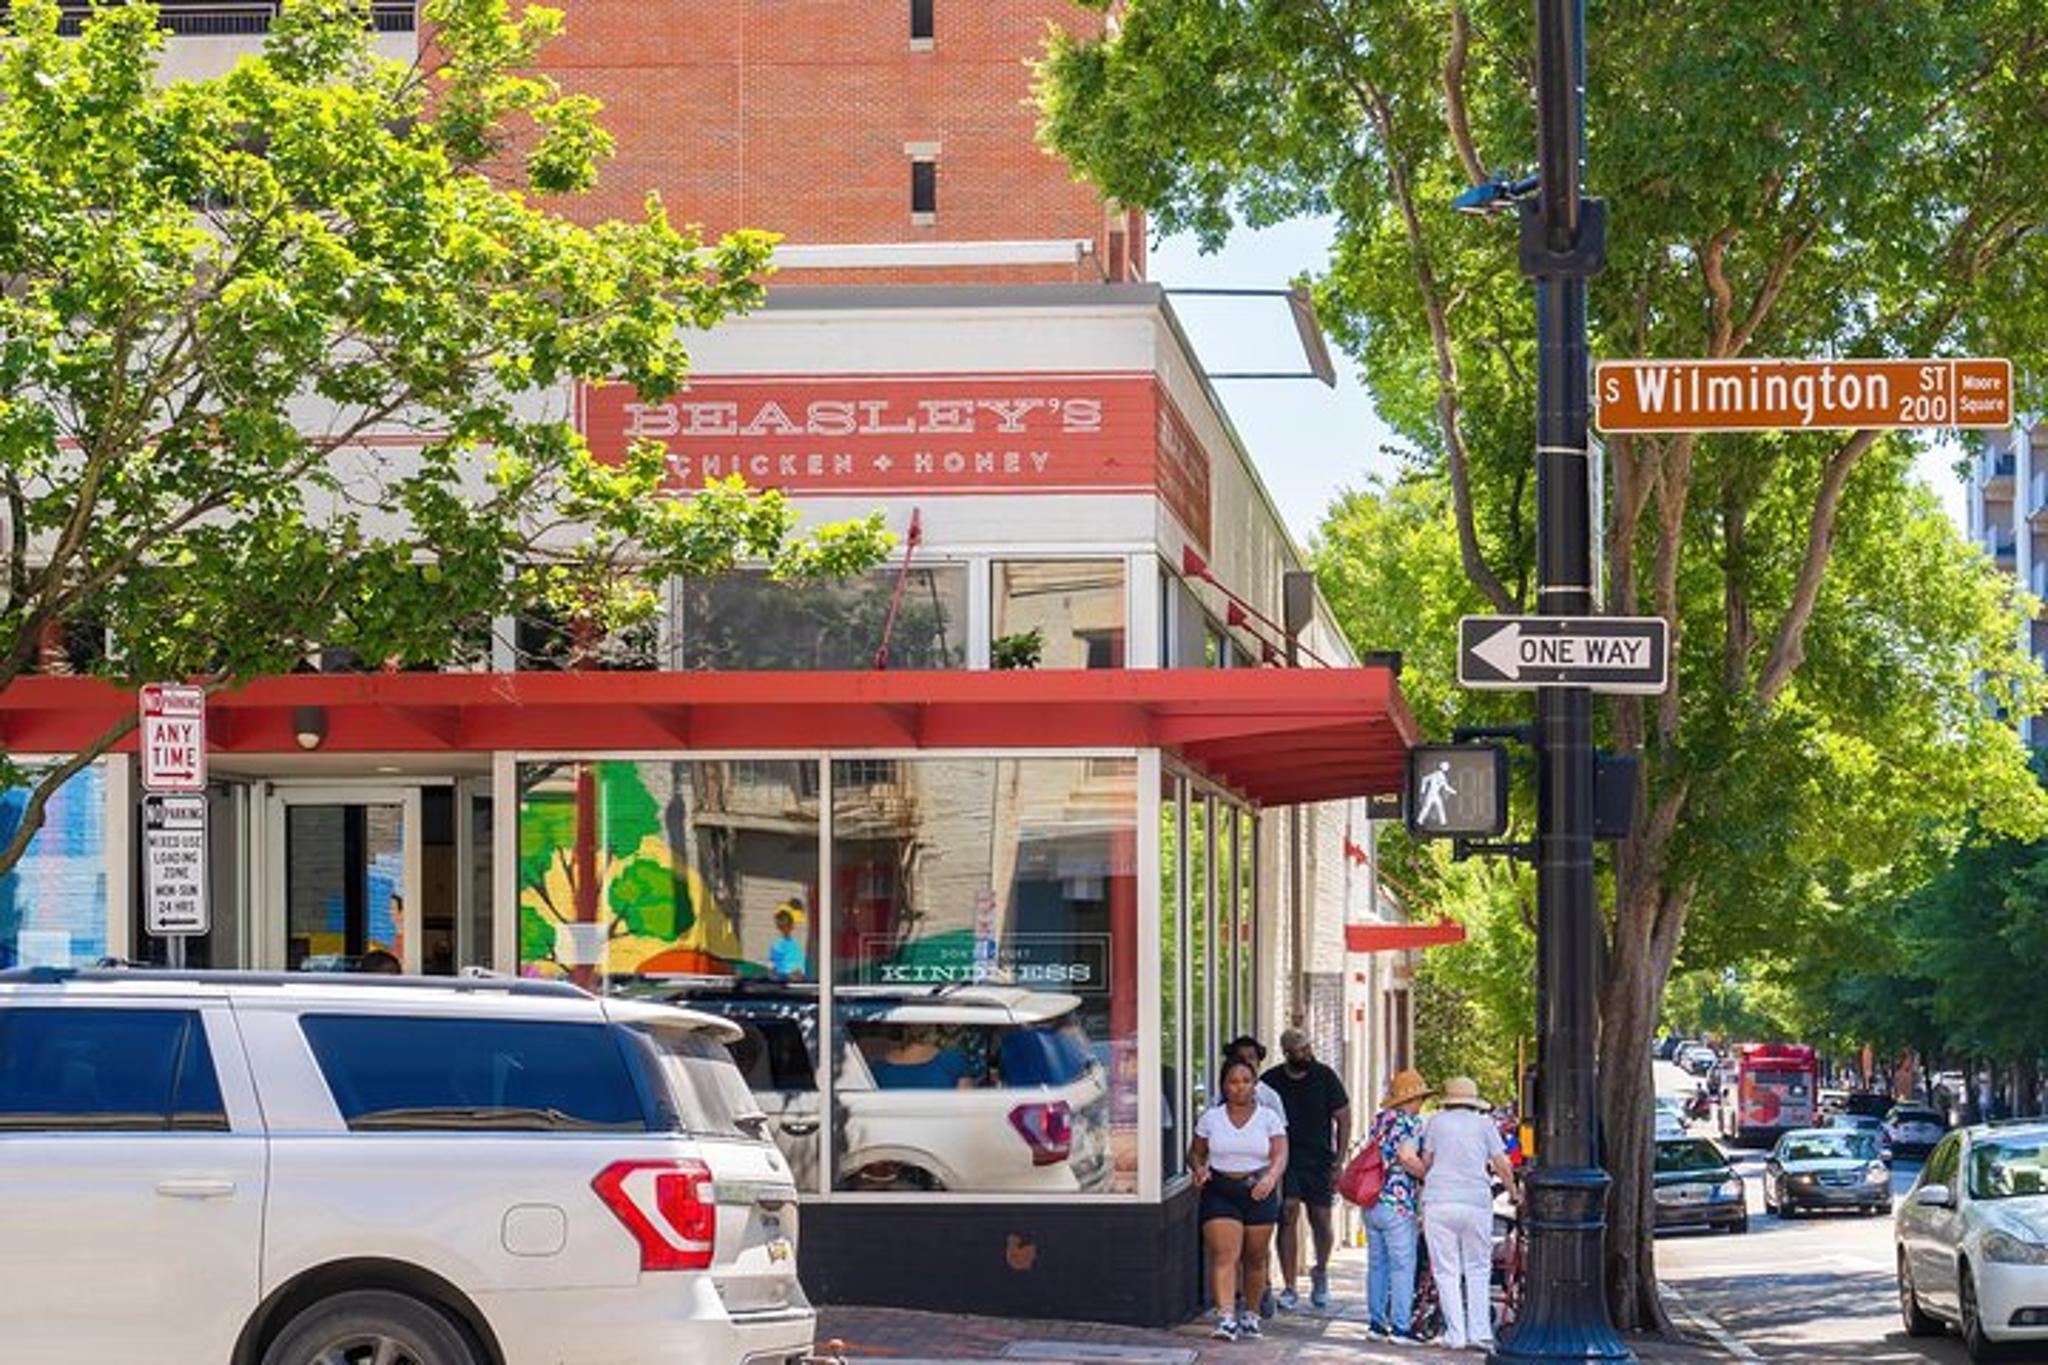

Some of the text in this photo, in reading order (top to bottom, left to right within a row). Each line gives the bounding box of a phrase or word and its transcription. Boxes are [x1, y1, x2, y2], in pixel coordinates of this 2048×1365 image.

[1919, 366, 1947, 391] ST
[1961, 375, 2001, 390] Moore
[1605, 366, 1889, 424] S Wilmington
[1960, 395, 2006, 413] Square
[622, 397, 1102, 436] BEASLEY'S
[1899, 394, 1947, 421] 200
[675, 453, 852, 476] CHICKEN
[914, 451, 1048, 474] HONEY
[1520, 639, 1642, 663] ONE WAY
[155, 724, 191, 743] ANY
[153, 747, 196, 767] TIME
[162, 806, 202, 819] PARKING
[148, 836, 201, 848] MIXED USE
[153, 851, 198, 864] LOADING
[164, 866, 189, 879] ZONE
[158, 901, 196, 913] 24 HRS
[881, 964, 1091, 982] KINDNESS
